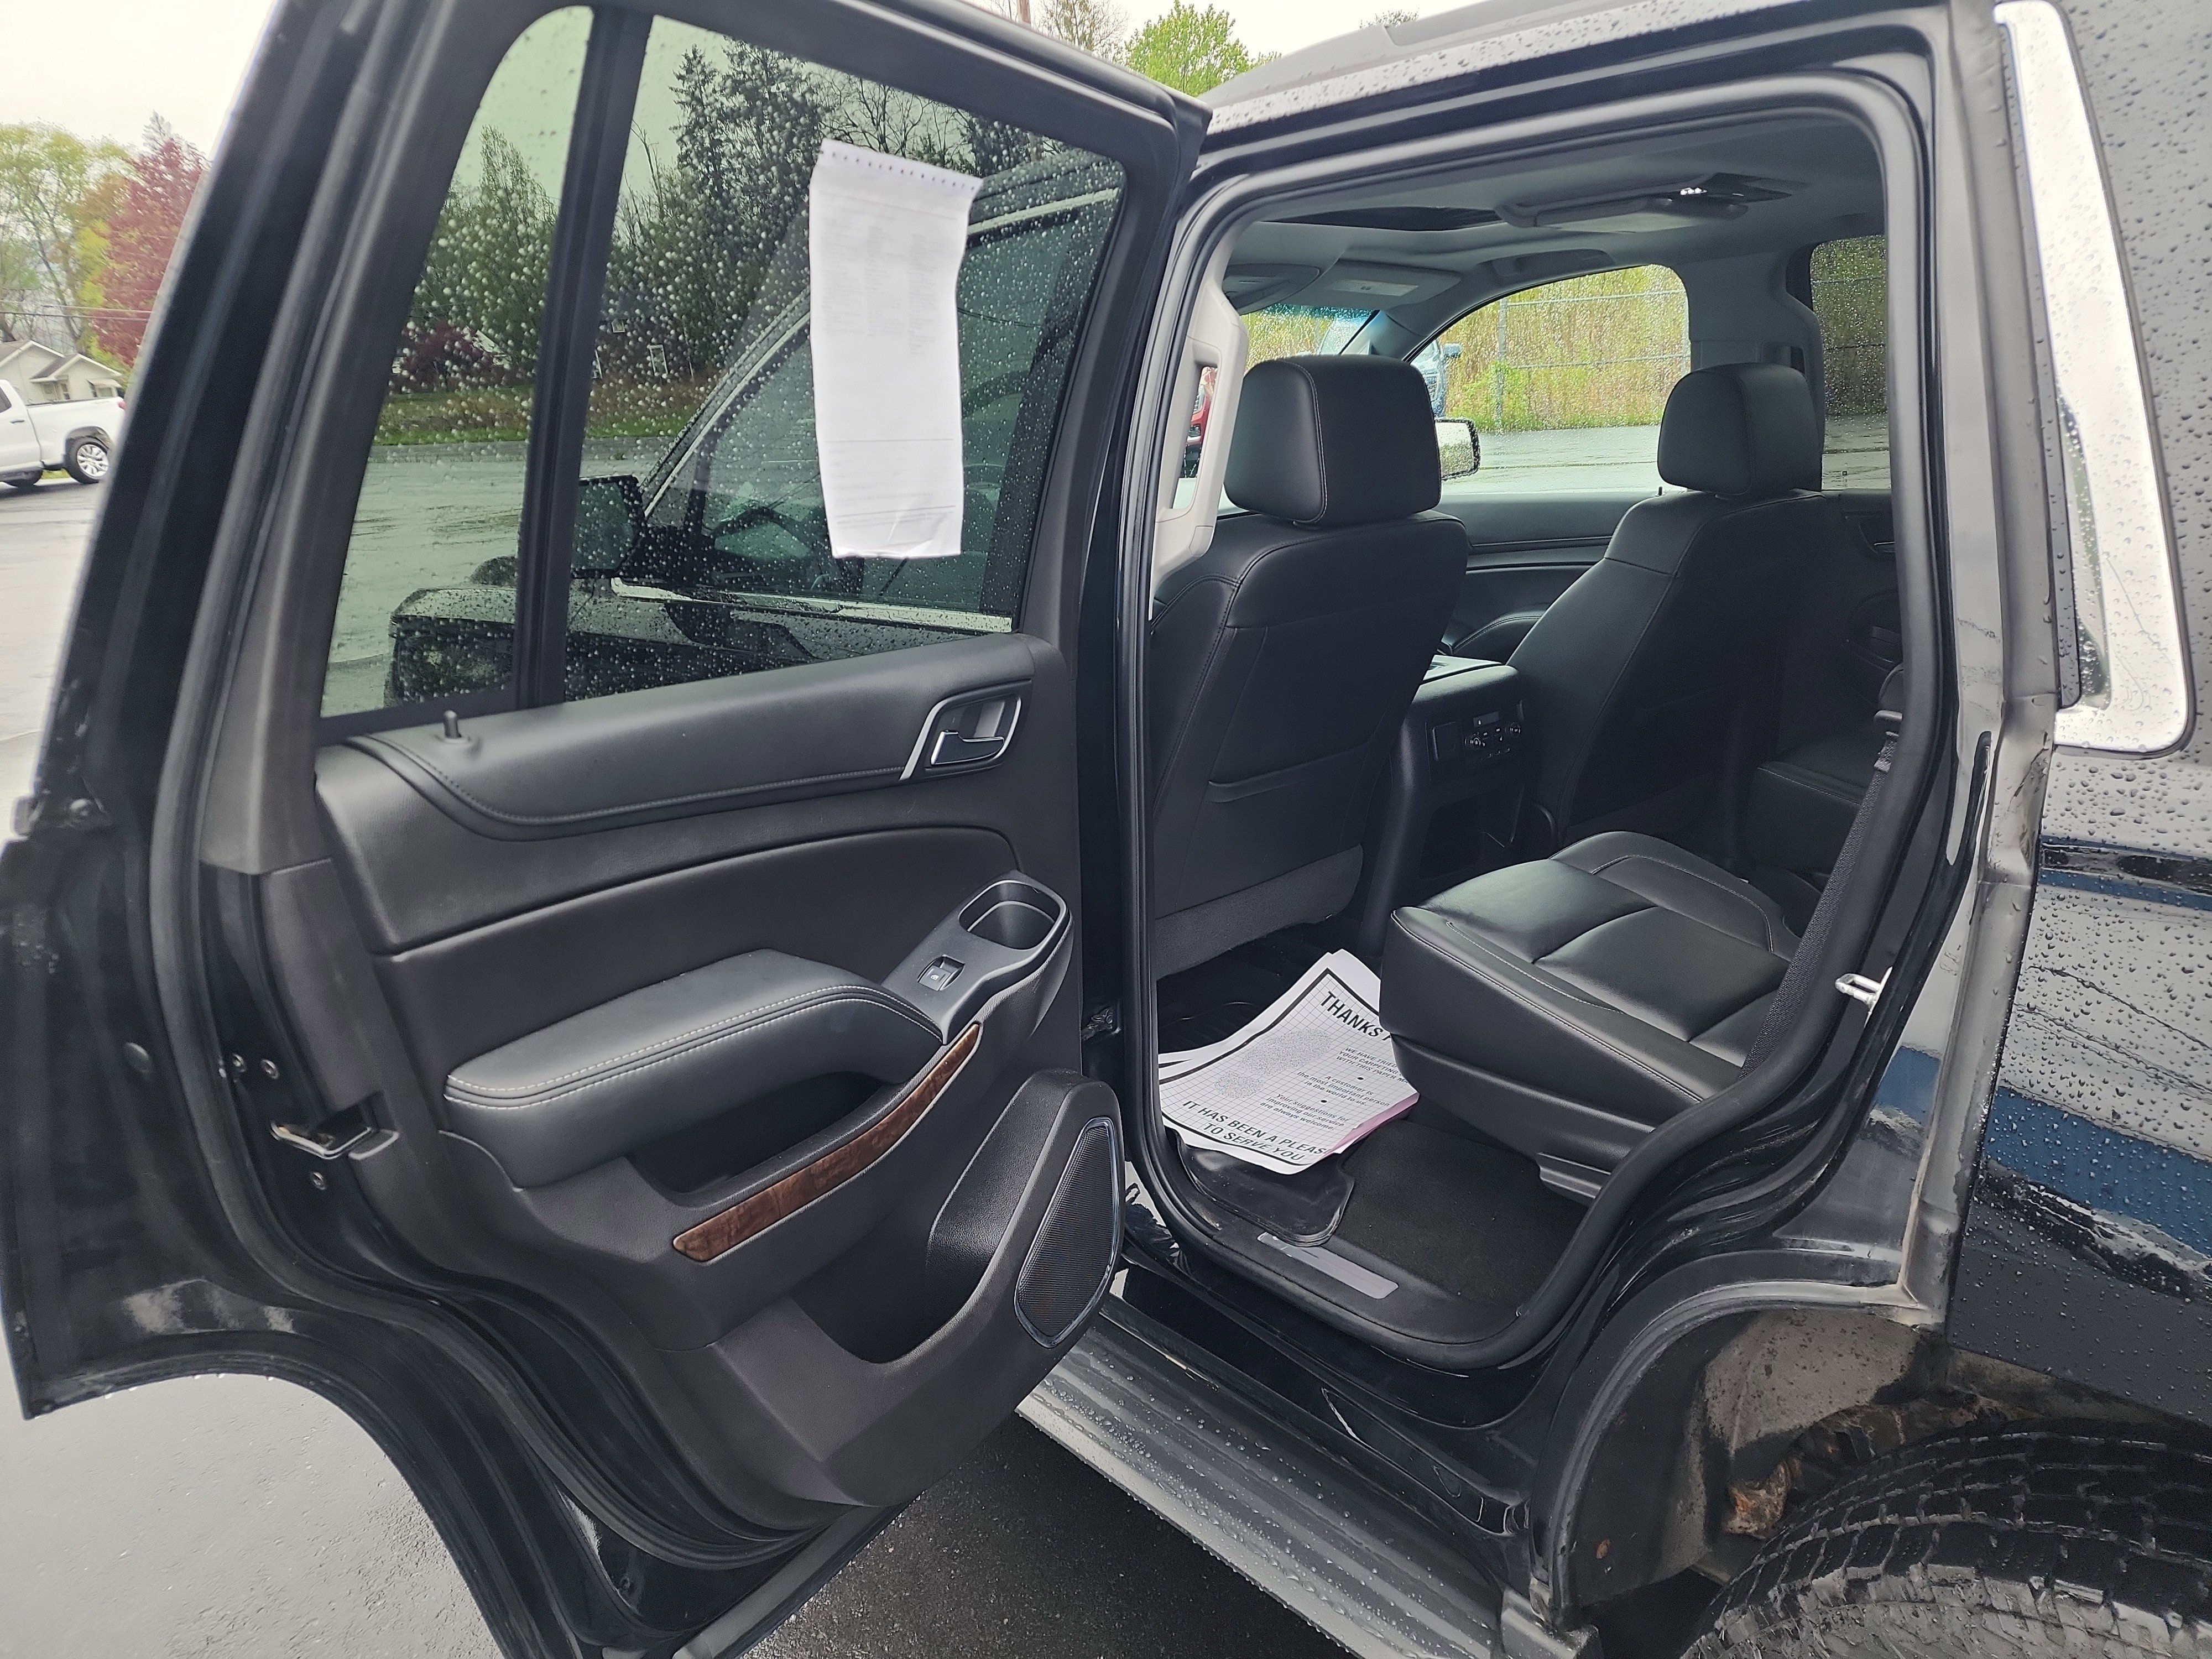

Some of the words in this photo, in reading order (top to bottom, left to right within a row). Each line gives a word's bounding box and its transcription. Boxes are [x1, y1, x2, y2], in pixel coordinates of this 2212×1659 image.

[1321, 991, 1383, 1037] THANKS
[1336, 1056, 1355, 1064] WITH
[1356, 1063, 1373, 1071] THIS
[1373, 1069, 1397, 1079] PAPER
[1339, 1051, 1358, 1060] YOUR
[1359, 1057, 1399, 1074] CARPETING
[1358, 1052, 1377, 1060] HAVE
[1378, 1058, 1397, 1068] TRIED
[1310, 1077, 1328, 1085] most
[1328, 1083, 1364, 1100] important
[1363, 1097, 1390, 1107] person
[1326, 1089, 1347, 1099] world
[1332, 1079, 1365, 1092] customer
[1266, 1097, 1303, 1114] improving
[1317, 1116, 1344, 1126] service
[1276, 1093, 1293, 1103] Your
[1292, 1100, 1337, 1118] suggestions
[1182, 1100, 1201, 1109] IT
[1197, 1107, 1229, 1123] HAS
[1227, 1120, 1267, 1138] BEEN
[1278, 1139, 1328, 1154] PLEAS
[1273, 1108, 1300, 1119] always
[1300, 1117, 1334, 1131] welcome.
[1203, 1123, 1224, 1134] TO
[1223, 1132, 1273, 1150] SERVE
[1272, 1147, 1305, 1161] YOU
